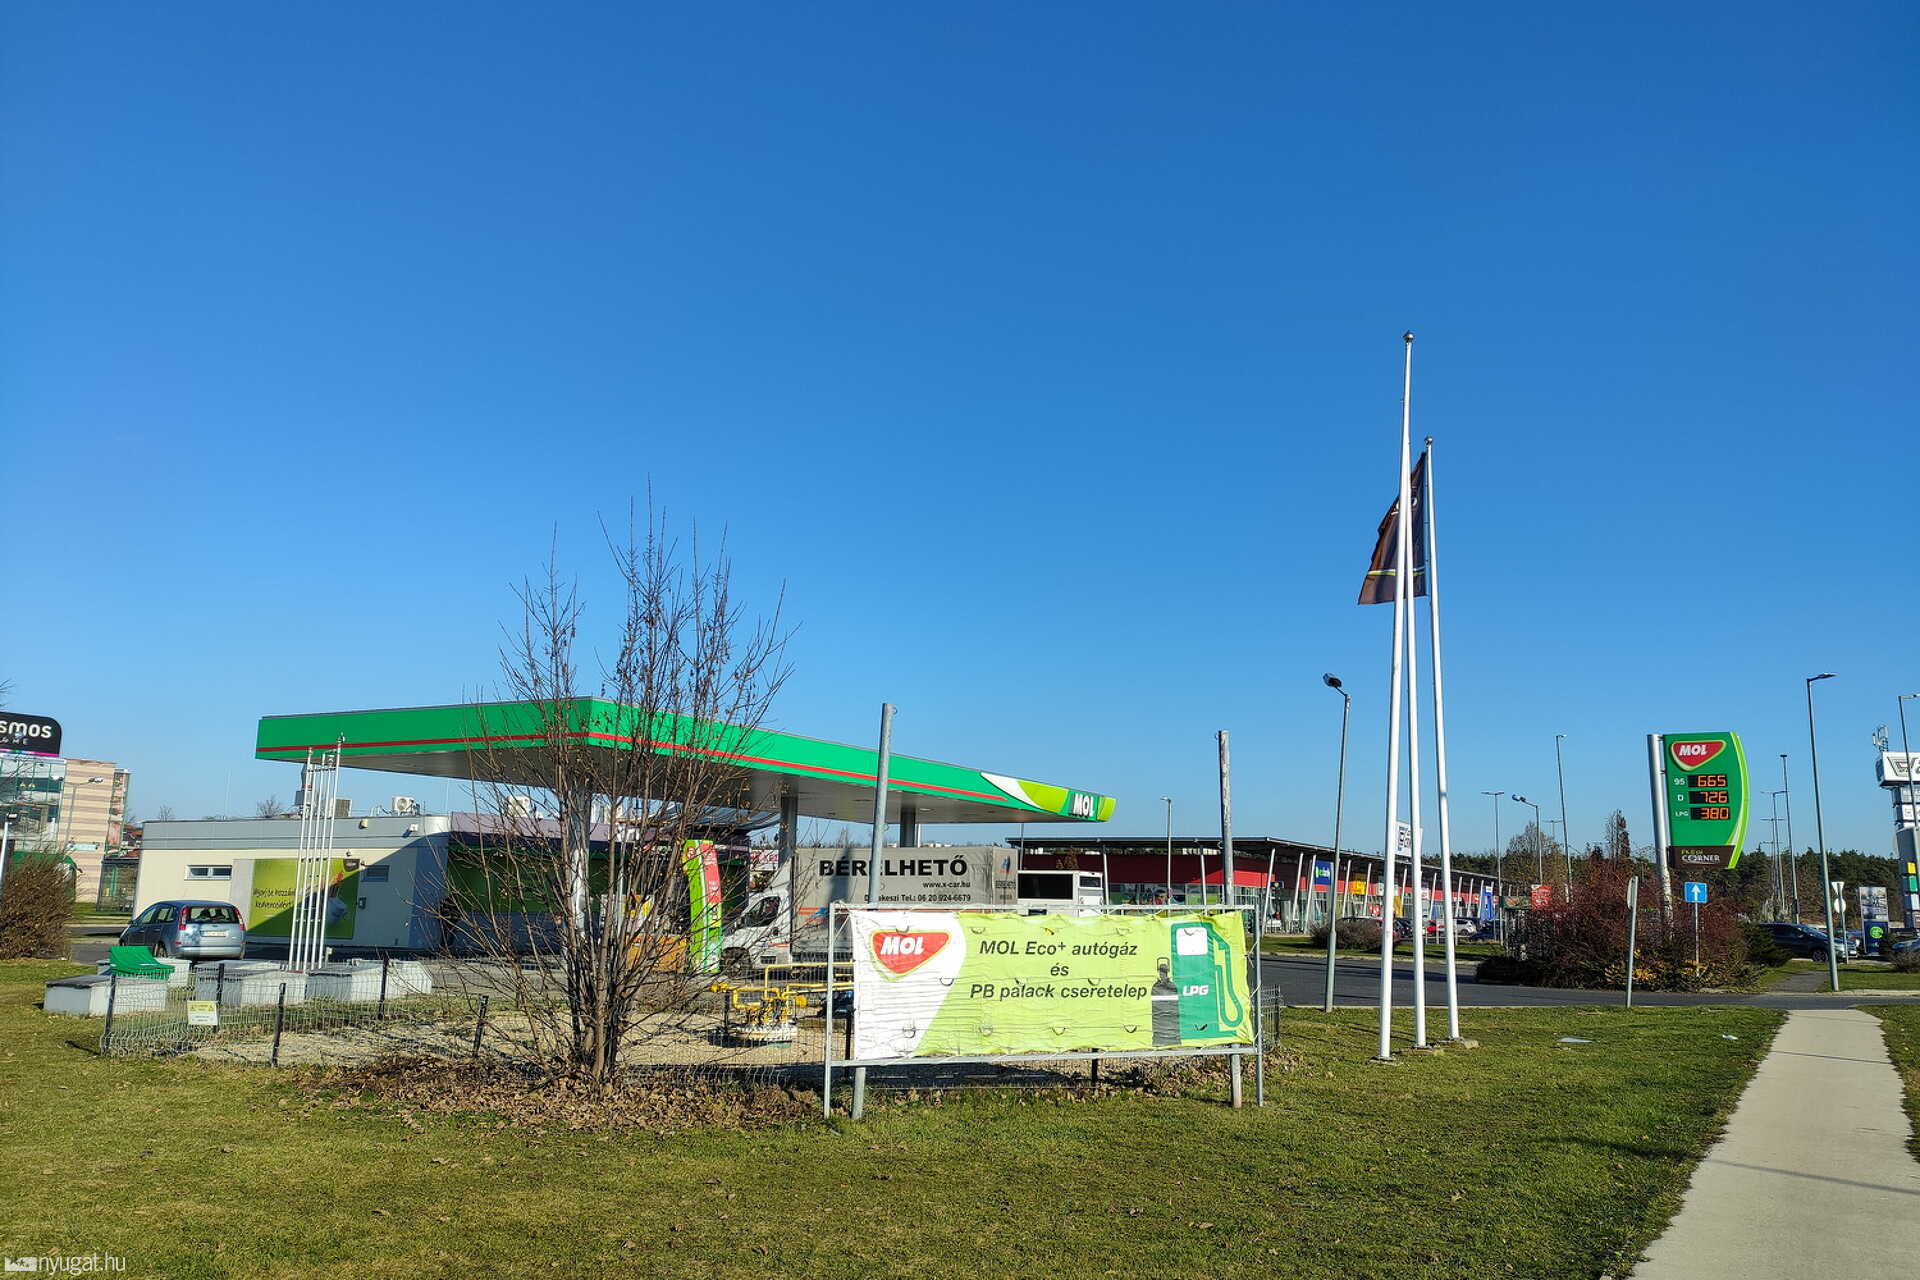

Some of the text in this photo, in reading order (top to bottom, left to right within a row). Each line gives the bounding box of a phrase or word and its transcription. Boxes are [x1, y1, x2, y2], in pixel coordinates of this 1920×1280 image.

[1680, 744, 1708, 756] MOL
[1674, 775, 1726, 787] 95 665
[1700, 791, 1728, 804] 726
[1073, 793, 1095, 817] MOL
[1700, 807, 1729, 820] 380
[819, 854, 968, 877] BÉRLHETŐ
[928, 894, 937, 902] 20
[880, 935, 926, 956] MOL
[979, 941, 1138, 959] MOL Eco+ autógáz
[1050, 964, 1069, 977] és
[969, 983, 1147, 1002] PB palack cseretelep
[1182, 985, 1209, 998] LPG
